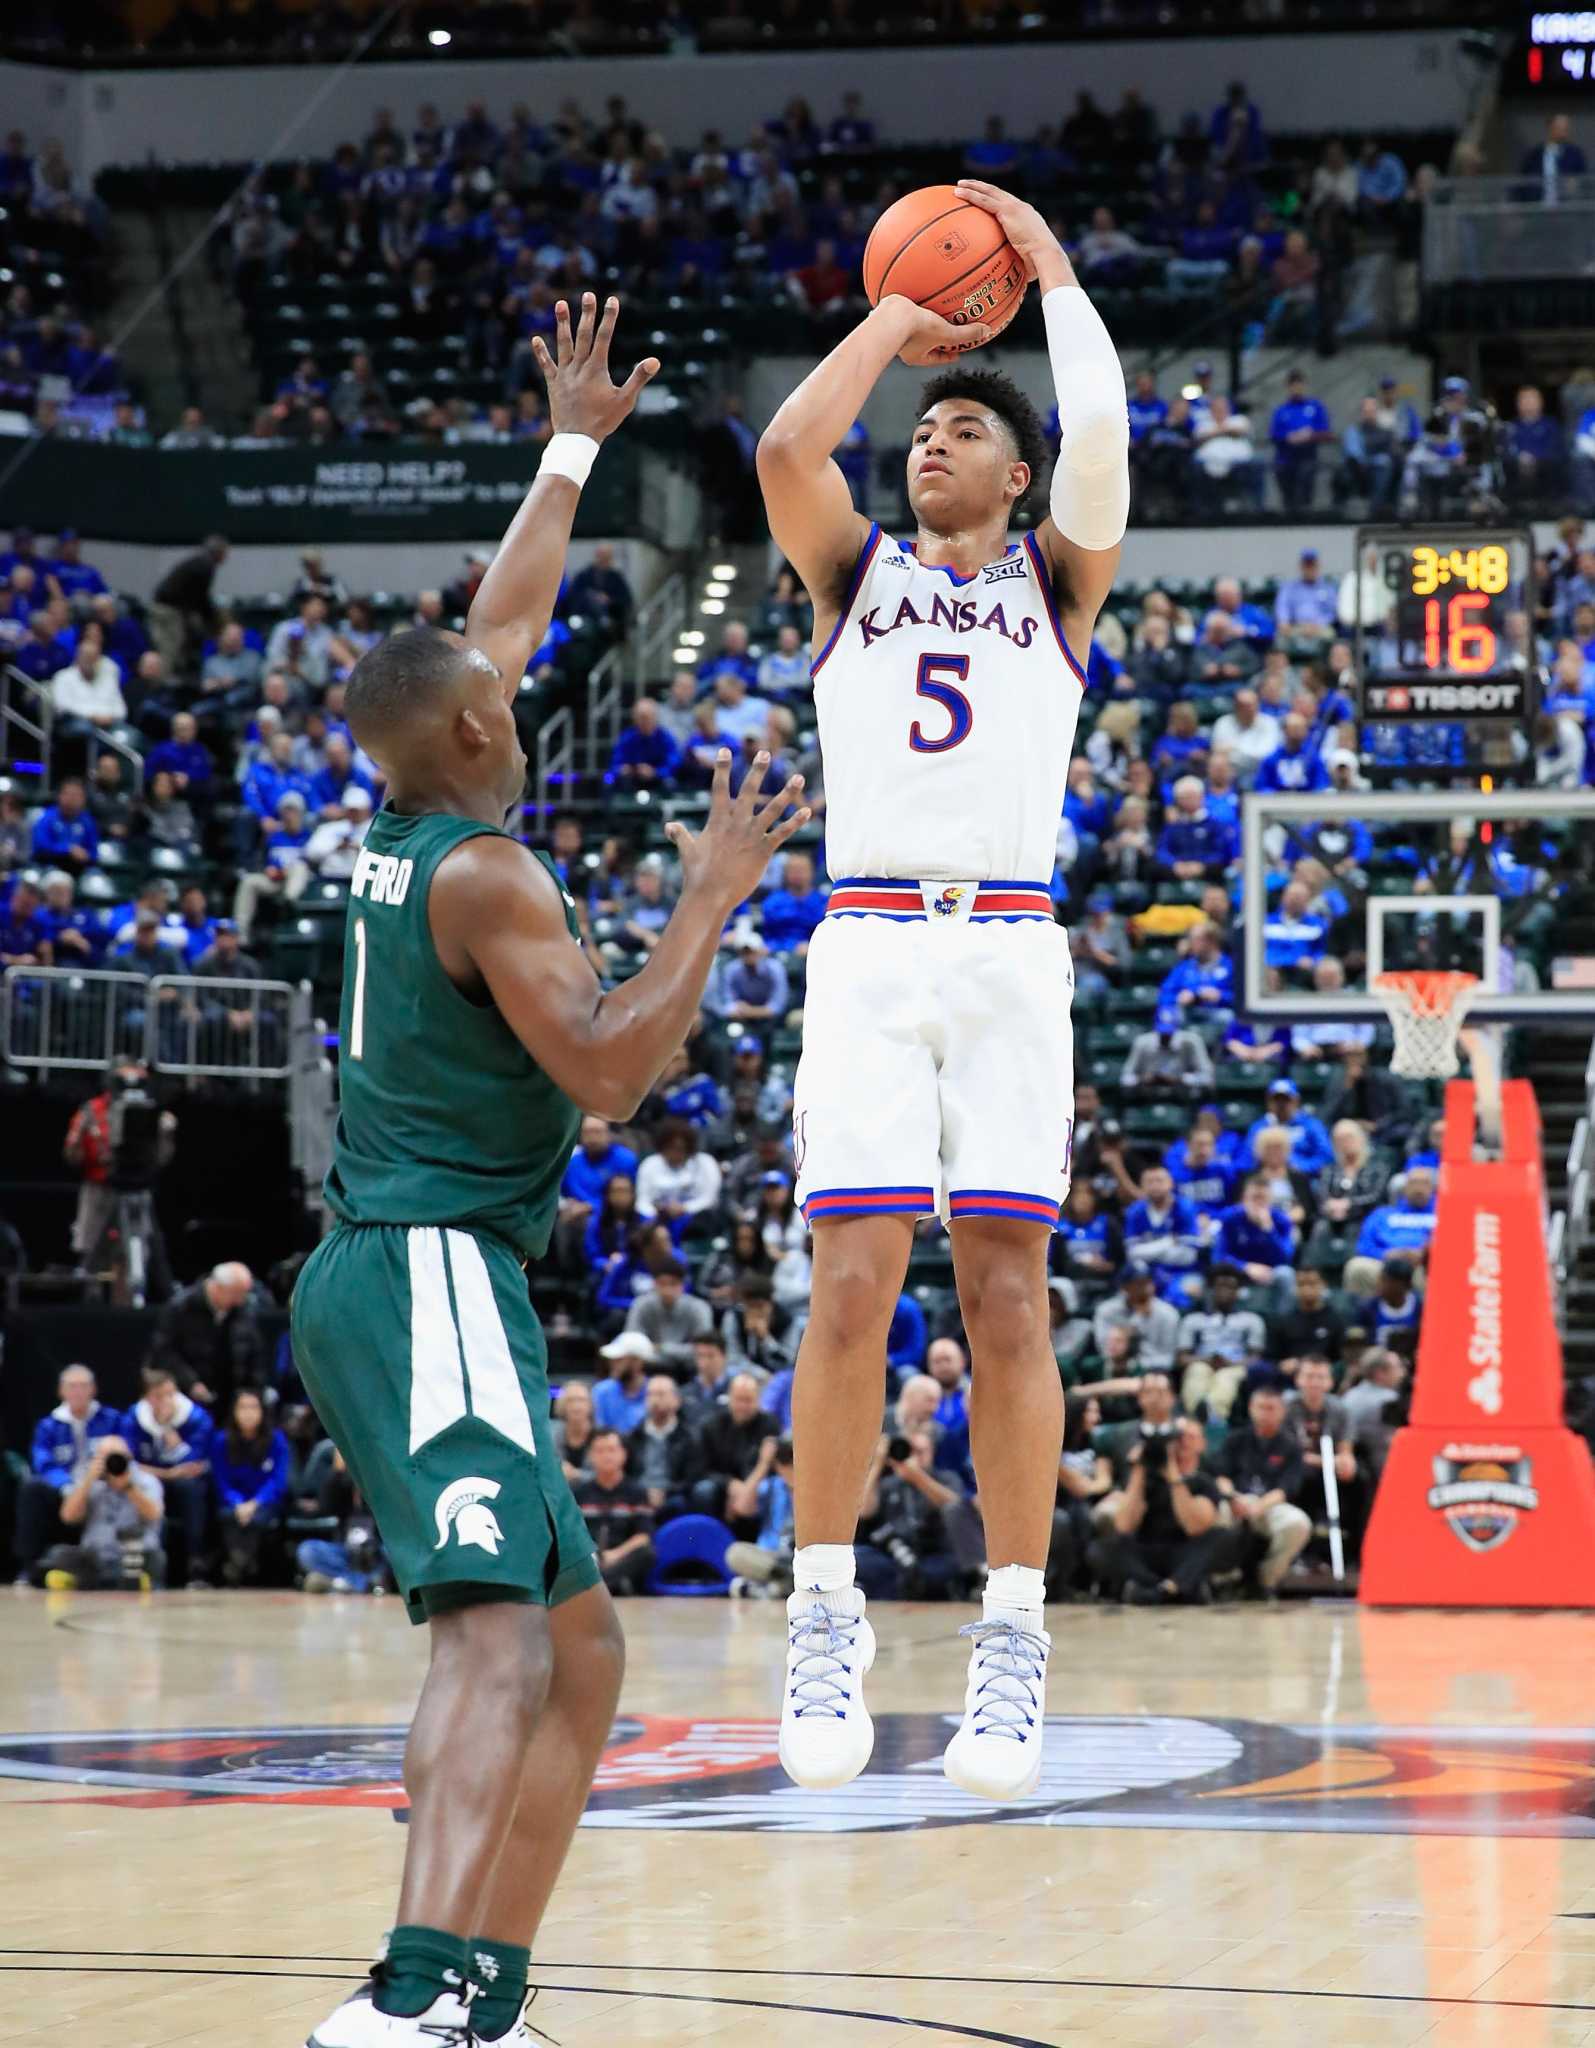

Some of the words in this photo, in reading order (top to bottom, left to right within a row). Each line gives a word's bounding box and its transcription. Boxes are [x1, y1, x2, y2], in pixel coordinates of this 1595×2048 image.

[963, 279, 997, 308] LEGACY
[315, 463, 384, 487] NEED
[387, 460, 466, 485] HELP?
[881, 558, 911, 571] adidas
[1412, 546, 1508, 595] 3:48
[858, 592, 1039, 649] KANSAS
[1425, 592, 1496, 673] 16
[909, 653, 972, 753] 5
[1409, 685, 1521, 711] TISSOT
[350, 918, 366, 1060] 1
